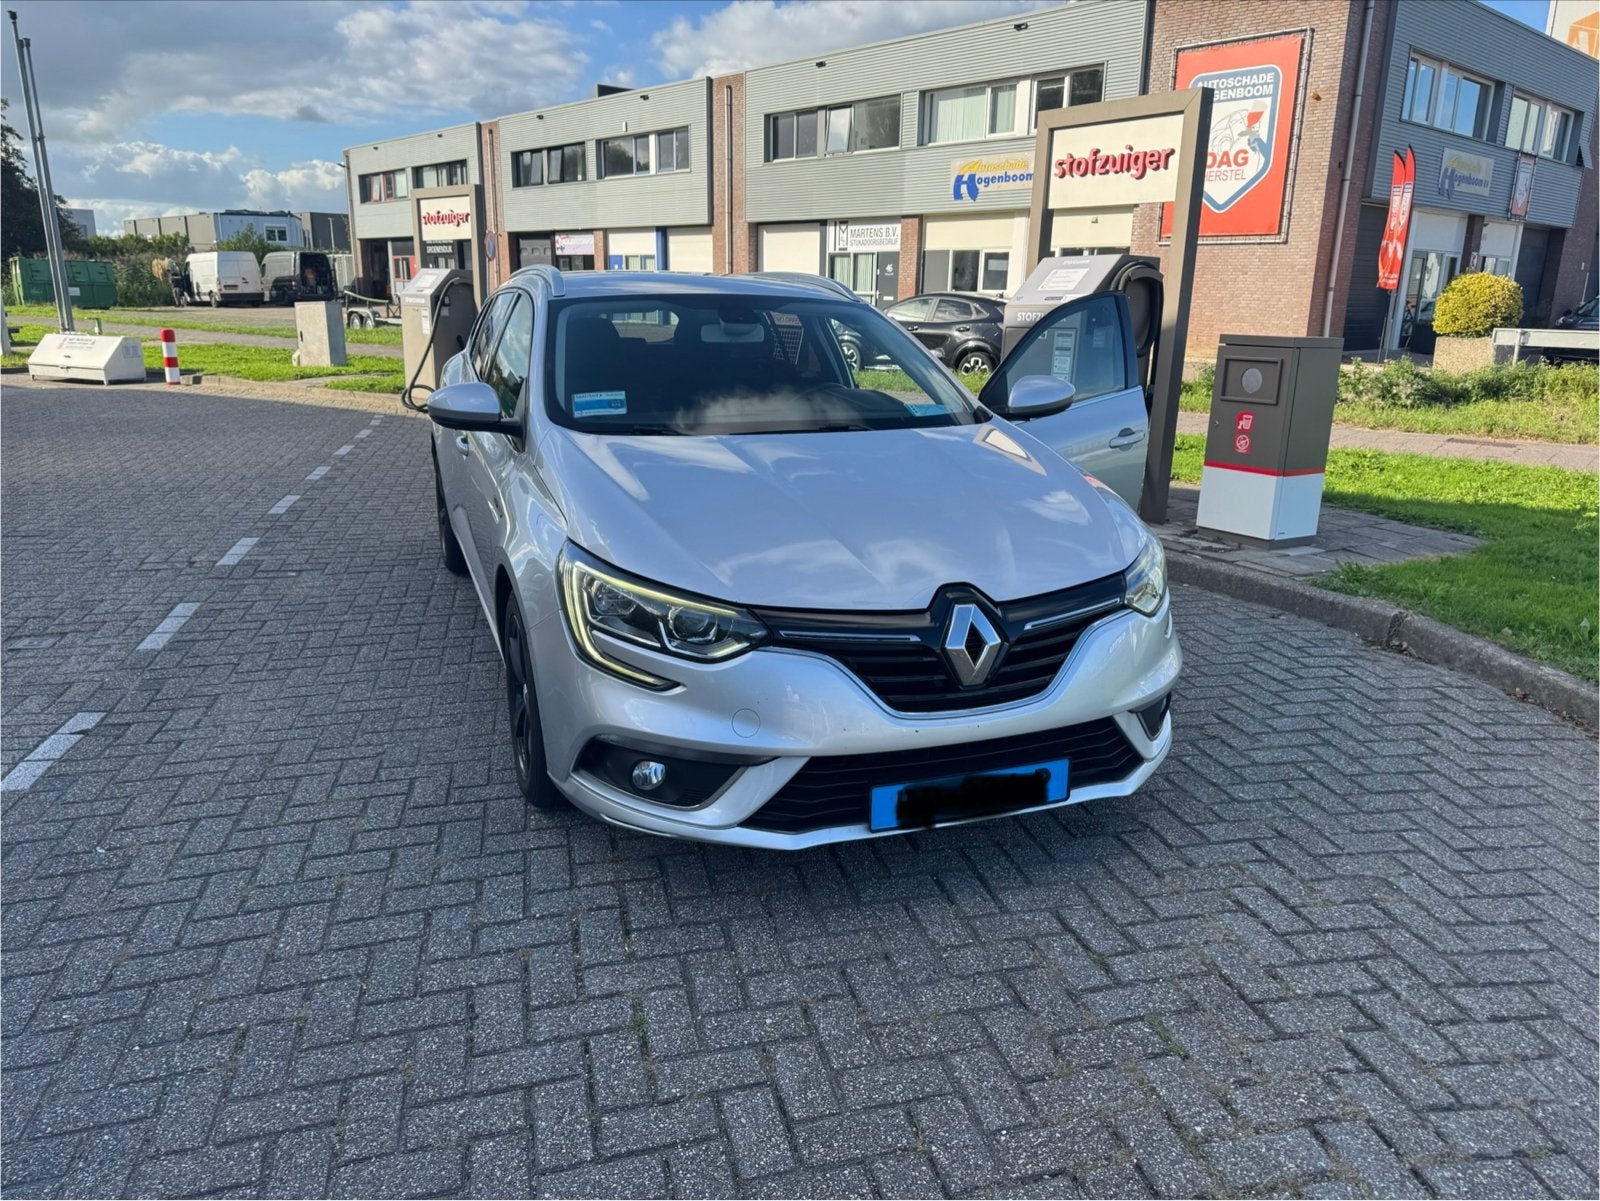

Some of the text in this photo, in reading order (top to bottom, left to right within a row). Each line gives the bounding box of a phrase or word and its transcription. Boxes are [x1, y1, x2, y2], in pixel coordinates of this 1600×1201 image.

[1197, 73, 1275, 90] AUTOSCHADE
[1213, 85, 1273, 101] GENBOOM
[959, 160, 1029, 174] Autoschade
[1054, 144, 1176, 180] stofzuiger
[849, 226, 899, 239] MARTENS B.V.
[1016, 311, 1044, 322] STOFZ
